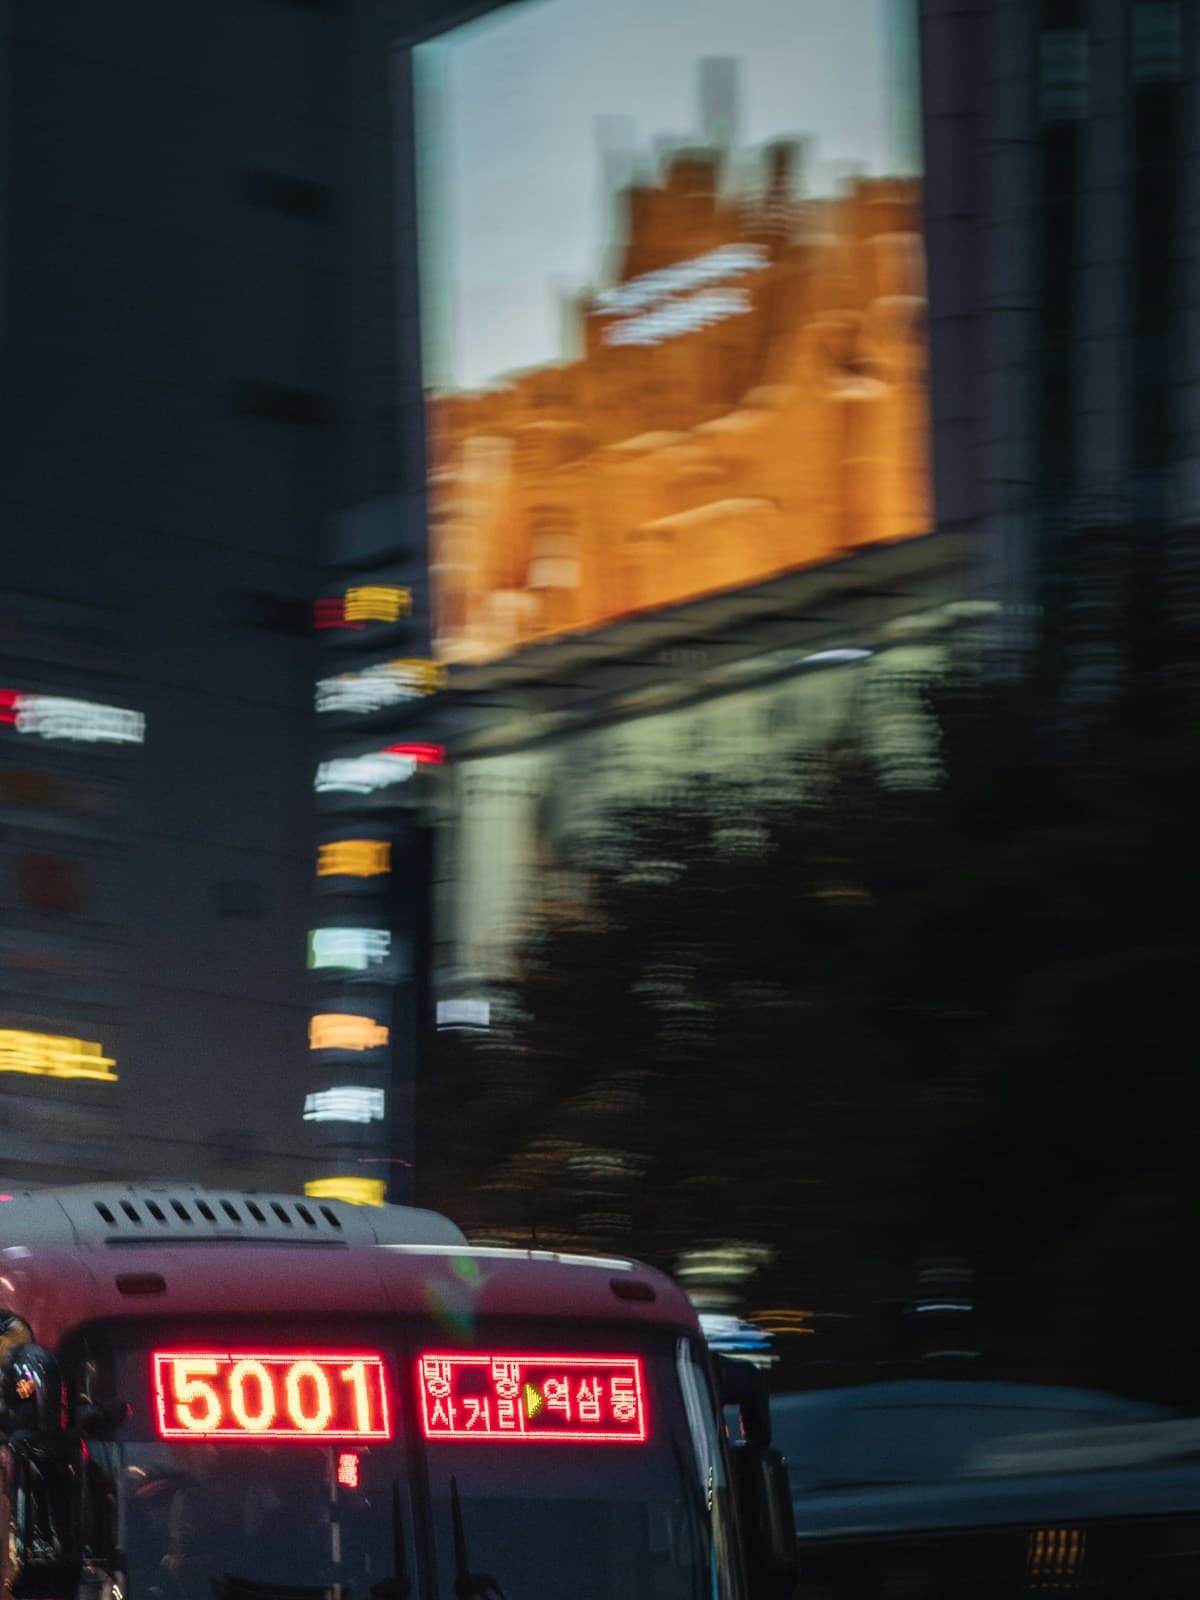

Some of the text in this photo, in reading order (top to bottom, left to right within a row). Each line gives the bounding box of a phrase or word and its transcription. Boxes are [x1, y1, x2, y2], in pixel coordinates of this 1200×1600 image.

[172, 1359, 372, 1433] 5001
[431, 1397, 525, 1432] 사거리
[543, 1376, 637, 1423] 역삼동
